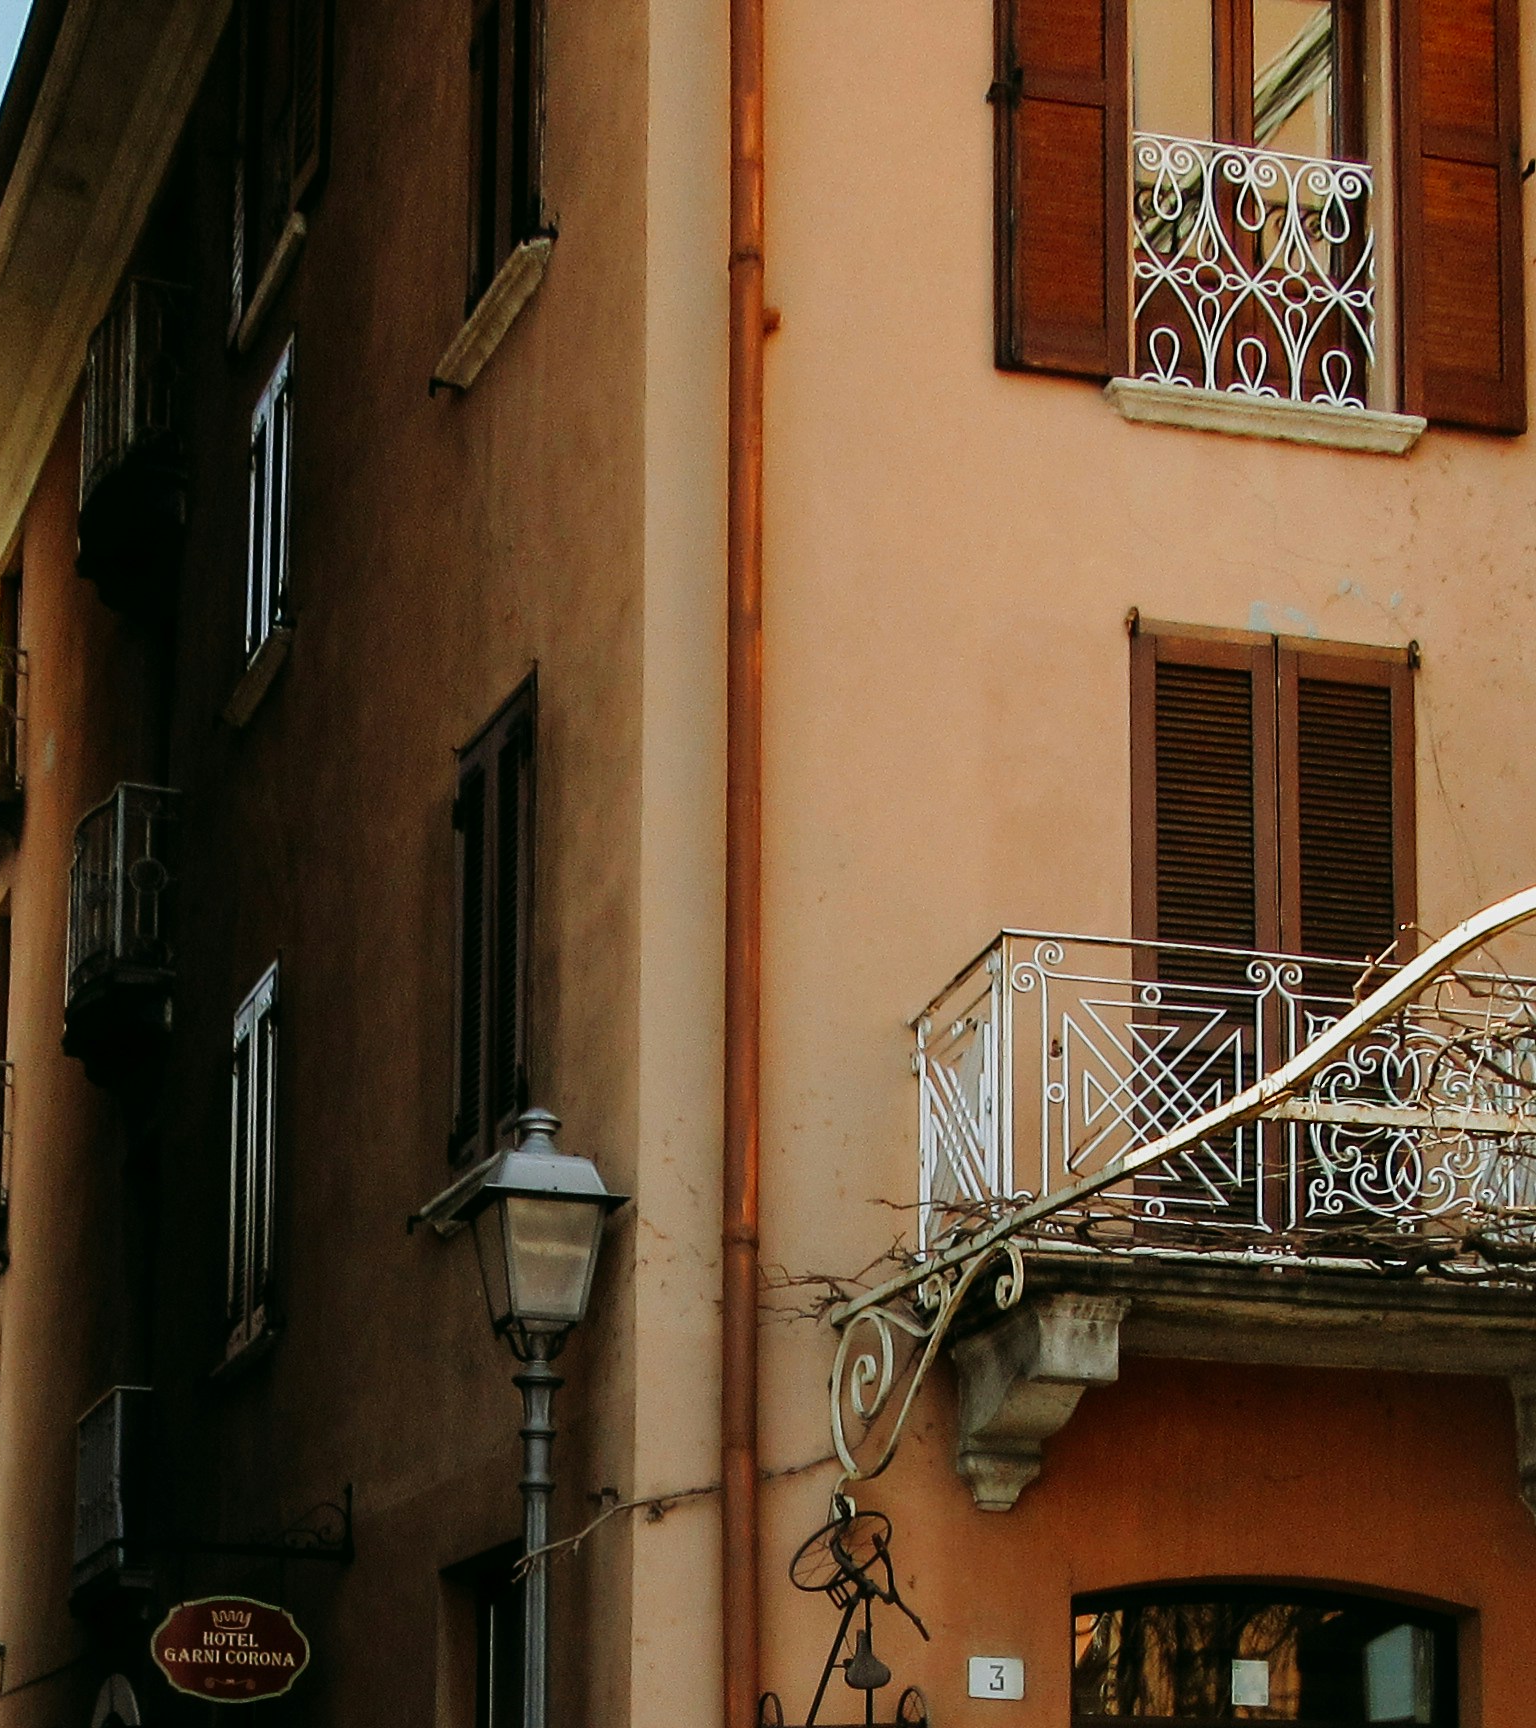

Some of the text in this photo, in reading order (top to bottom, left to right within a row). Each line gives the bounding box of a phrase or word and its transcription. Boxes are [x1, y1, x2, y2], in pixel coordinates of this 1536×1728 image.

[203, 1631, 259, 1648] HOTEL
[164, 1648, 296, 1667] GARNI CORONA
[989, 1665, 1004, 1691] 3
